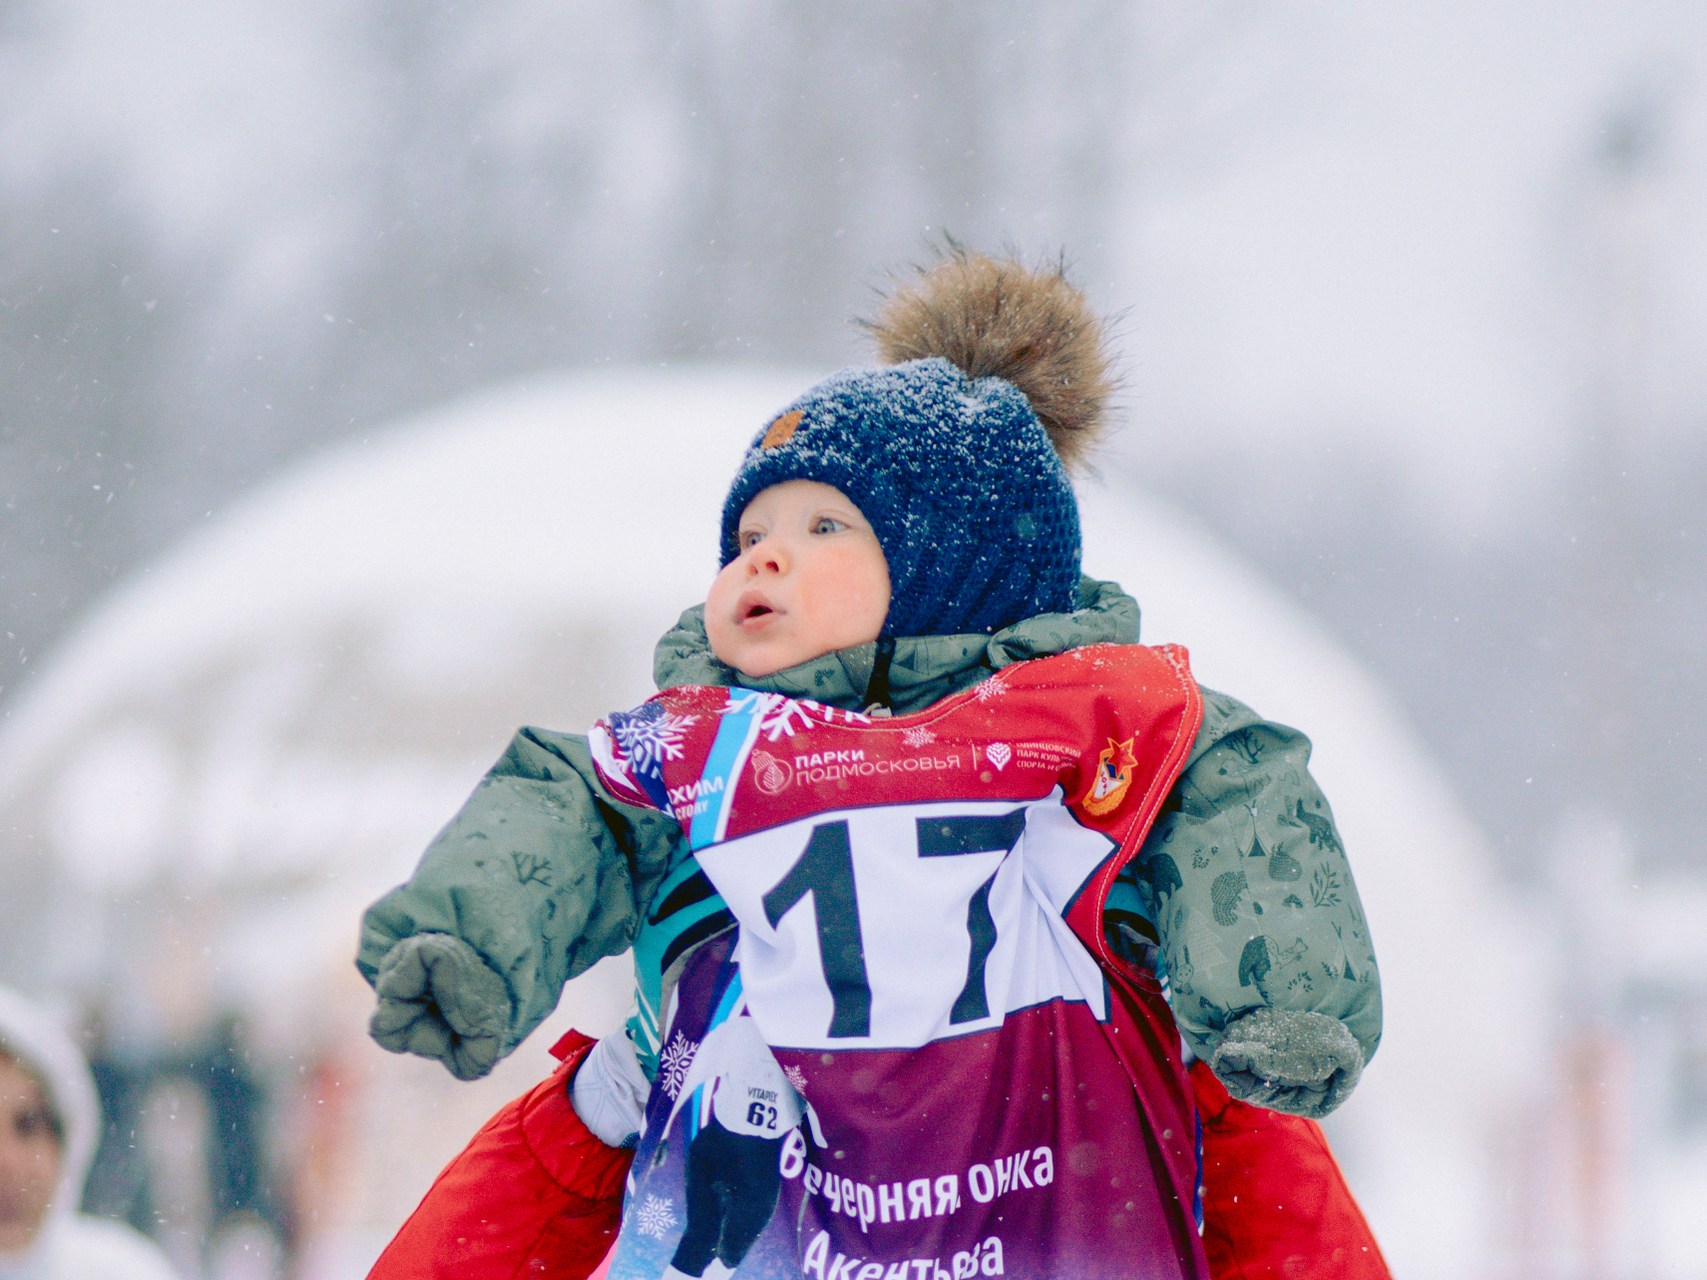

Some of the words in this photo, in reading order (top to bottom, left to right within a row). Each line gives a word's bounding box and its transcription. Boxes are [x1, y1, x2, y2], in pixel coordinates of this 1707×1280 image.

[794, 750, 865, 769] ПАРКИ
[1017, 749, 1039, 760] ПАРК
[796, 754, 961, 786] ПОДМОСКОВЬЯ
[675, 800, 709, 820] CTORY
[762, 807, 1026, 1038] 17
[746, 1101, 778, 1130] 62
[780, 1127, 957, 1233] Вечерняя
[953, 1146, 1054, 1207] онка
